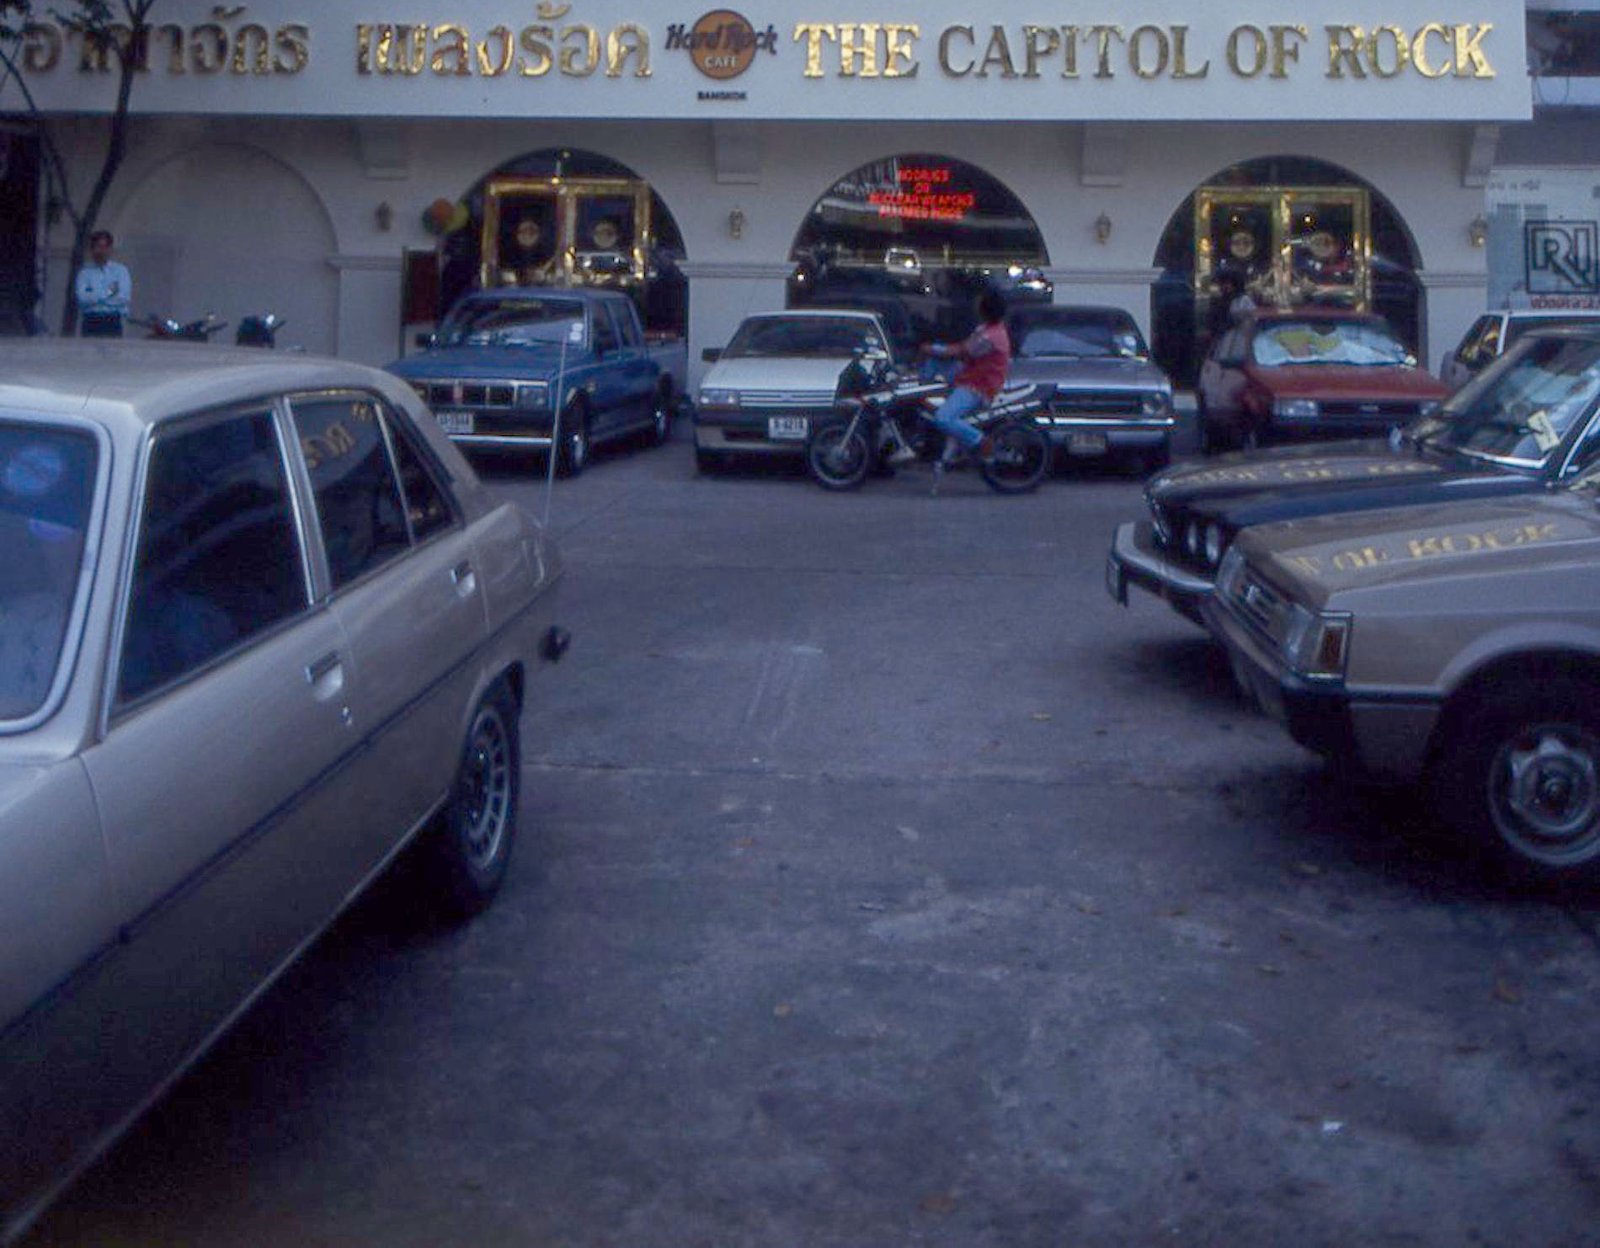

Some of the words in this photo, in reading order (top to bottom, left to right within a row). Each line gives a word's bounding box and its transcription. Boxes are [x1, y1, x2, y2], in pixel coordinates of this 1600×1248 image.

[793, 23, 921, 79] THE
[938, 23, 1211, 80] CAPITOL
[1226, 23, 1307, 79] OF
[1324, 22, 1497, 79] ROCK
[704, 56, 737, 69] CAFE
[698, 91, 747, 100] BANGKOK
